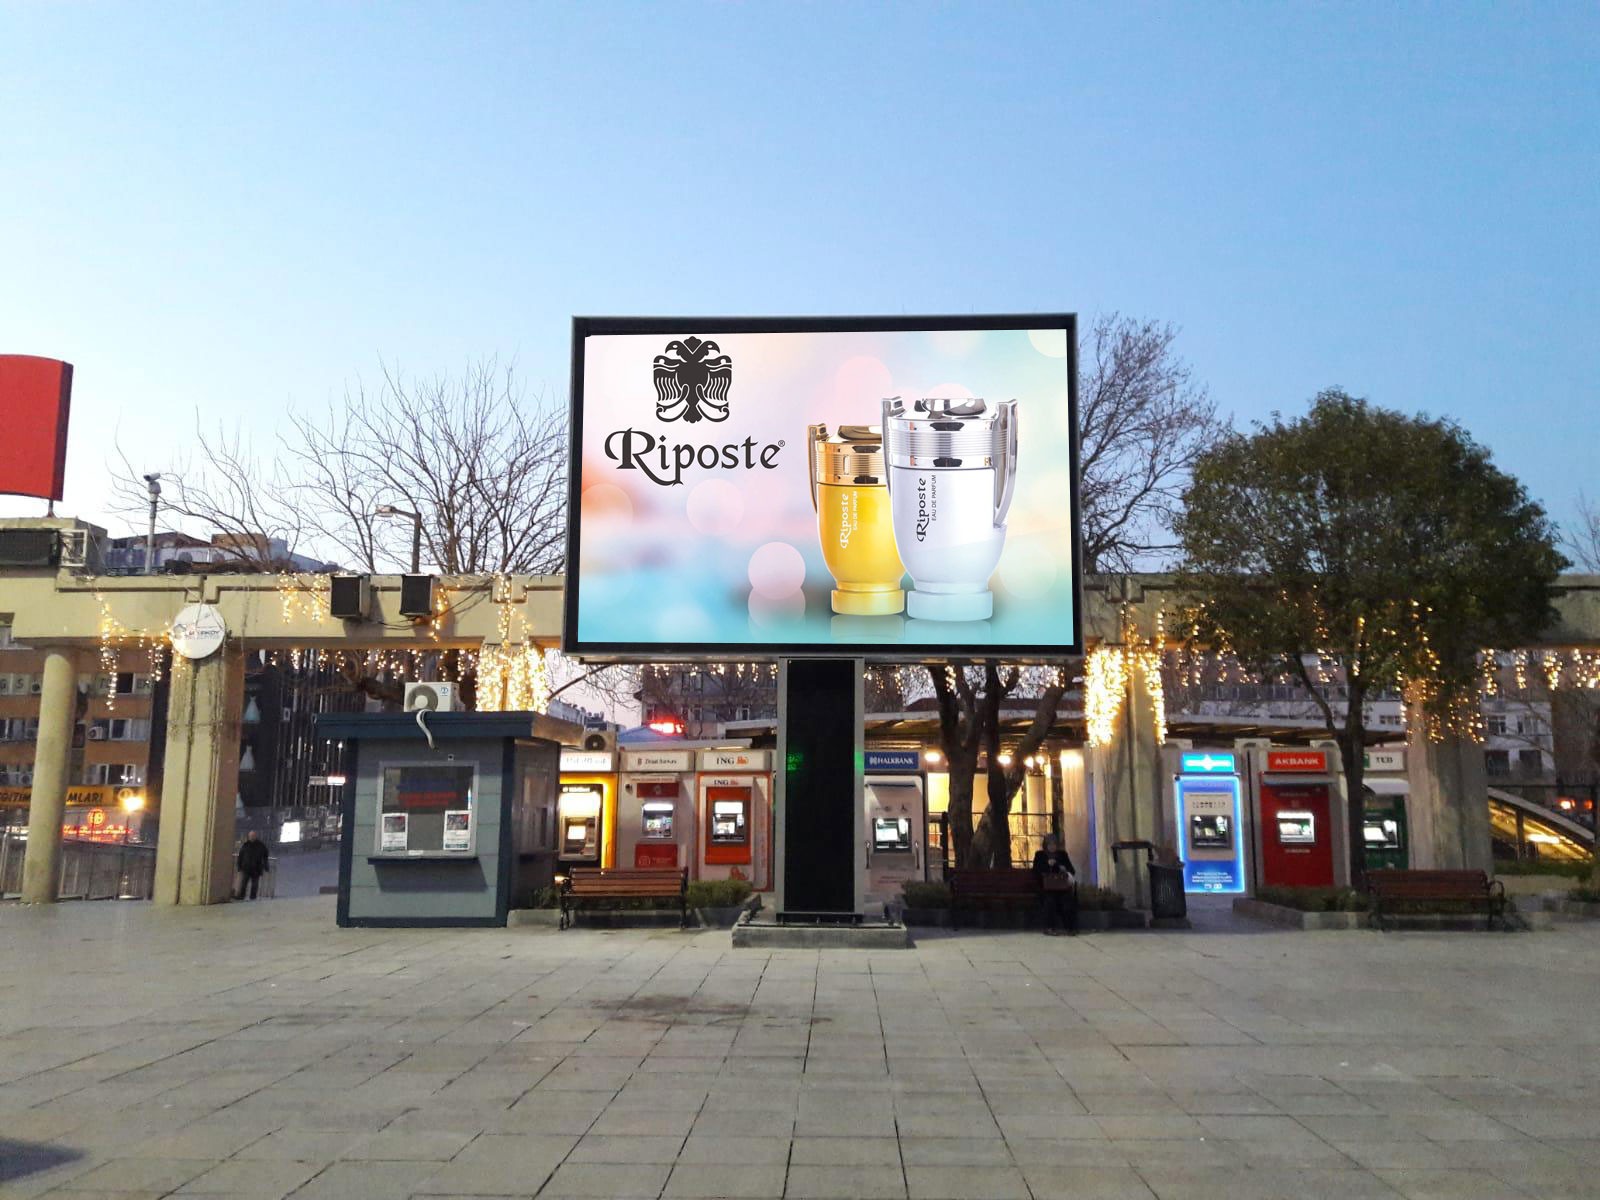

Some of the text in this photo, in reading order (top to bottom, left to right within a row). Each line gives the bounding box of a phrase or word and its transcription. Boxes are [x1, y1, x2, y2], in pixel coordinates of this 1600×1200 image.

[931, 500, 937, 508] DE
[916, 477, 930, 542] Riposte
[840, 493, 852, 549] Riposte
[716, 757, 735, 765] ING
[877, 756, 914, 765] HALKBANK
[1275, 757, 1319, 765] AKBANK
